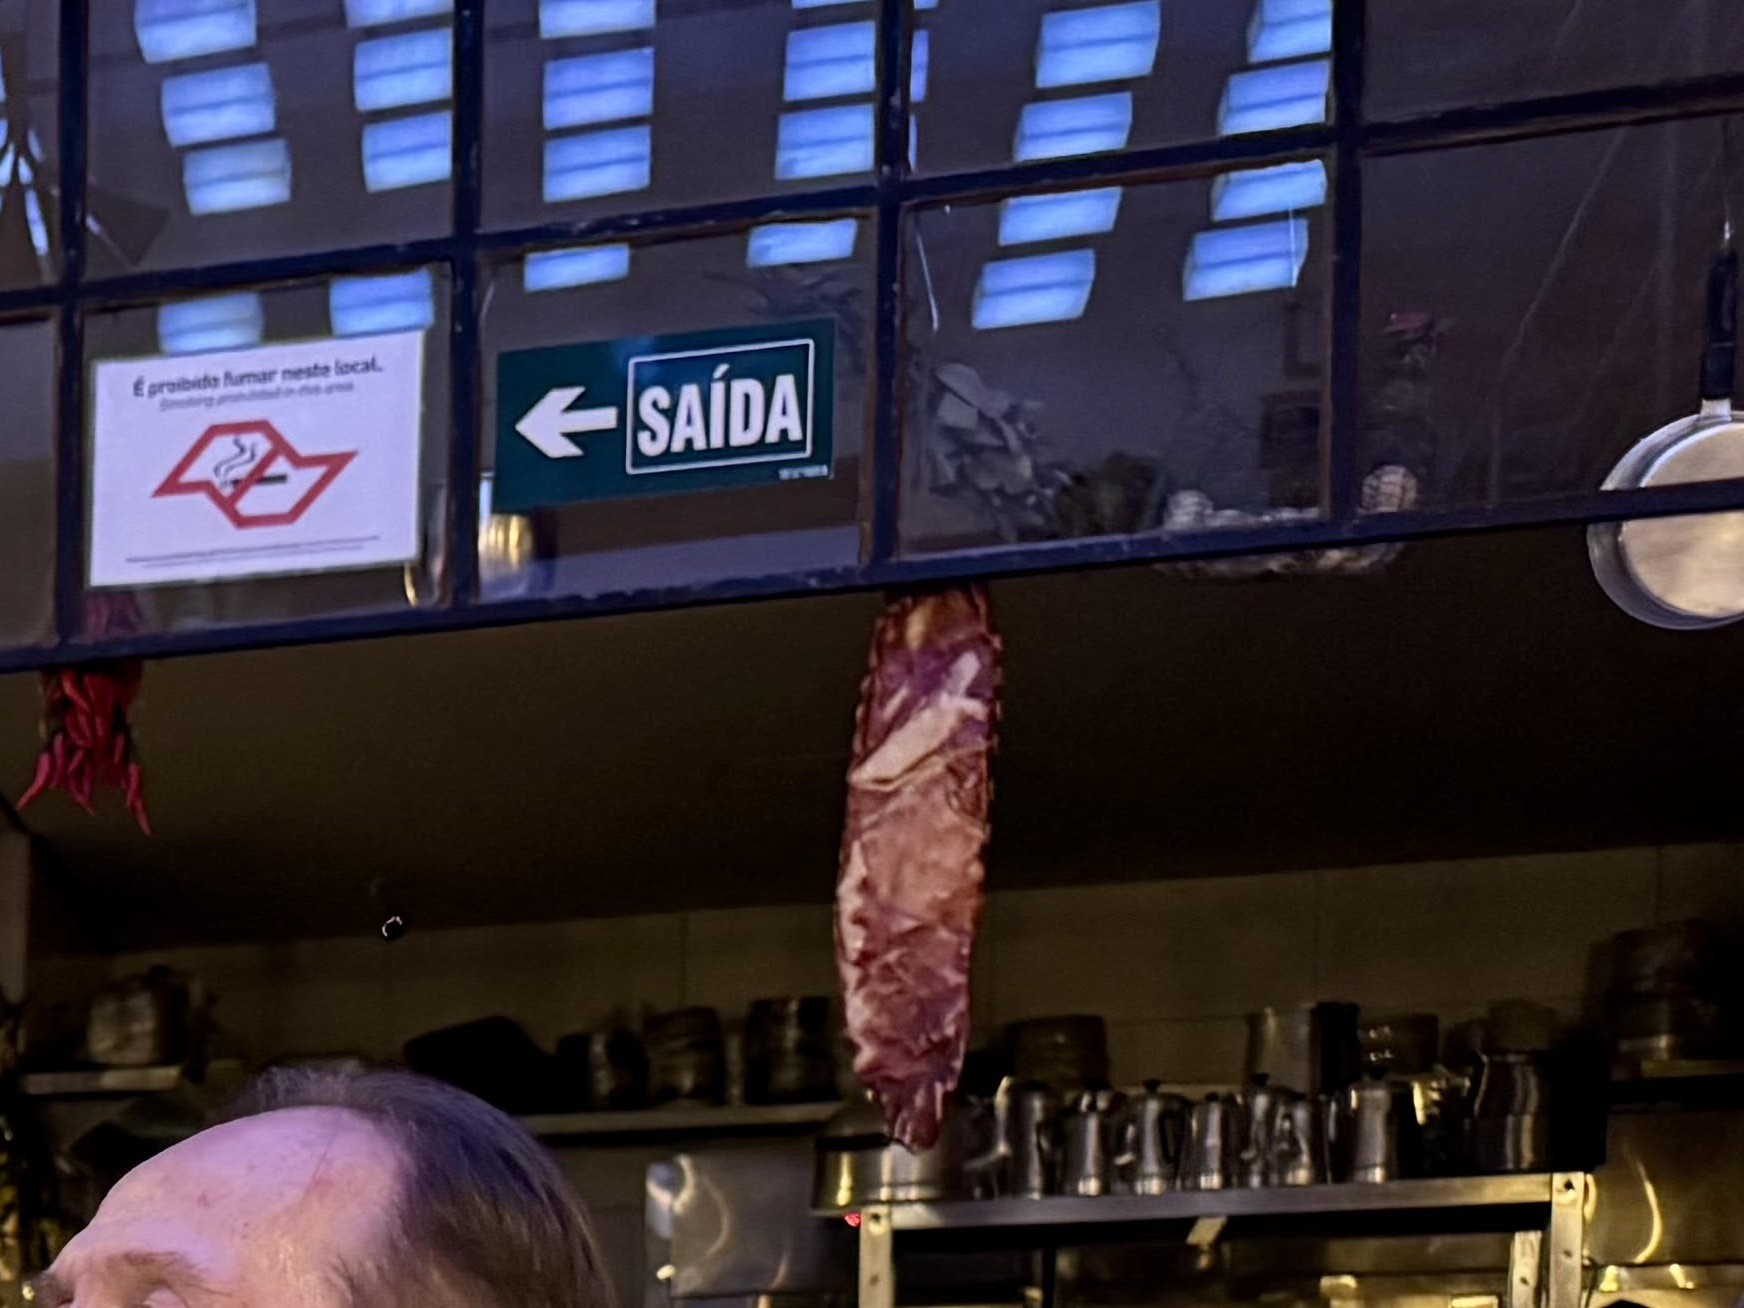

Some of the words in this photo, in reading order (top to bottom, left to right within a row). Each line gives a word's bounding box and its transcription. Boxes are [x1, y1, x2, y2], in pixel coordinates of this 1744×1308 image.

[147, 371, 220, 398] proibido
[222, 369, 276, 389] fumar
[281, 361, 332, 383] neste
[636, 363, 804, 457] SAÍDA
